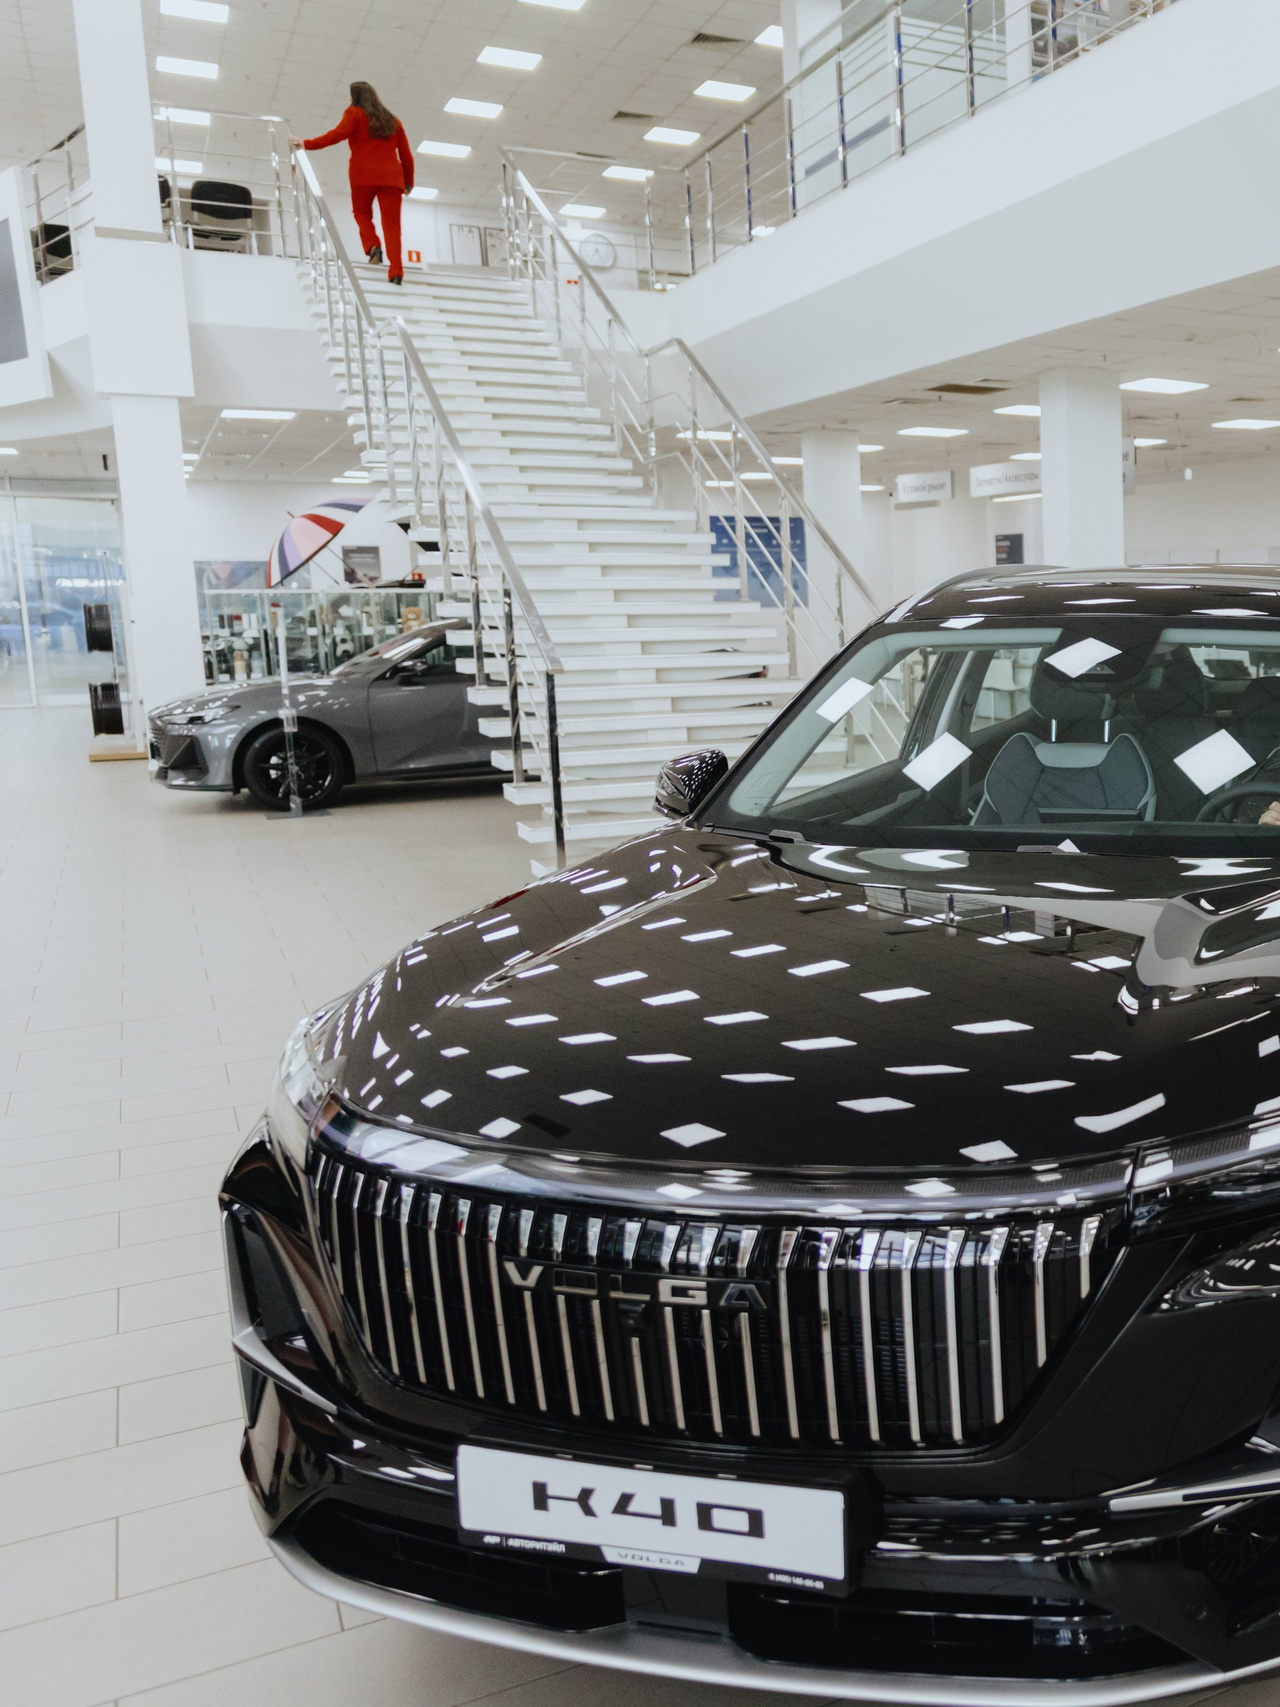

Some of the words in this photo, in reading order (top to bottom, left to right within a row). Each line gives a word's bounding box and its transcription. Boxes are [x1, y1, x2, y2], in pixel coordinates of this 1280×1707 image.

[503, 1260, 768, 1310] VOLGA
[532, 1480, 765, 1539] K40
[617, 1551, 686, 1567] VOLGA
